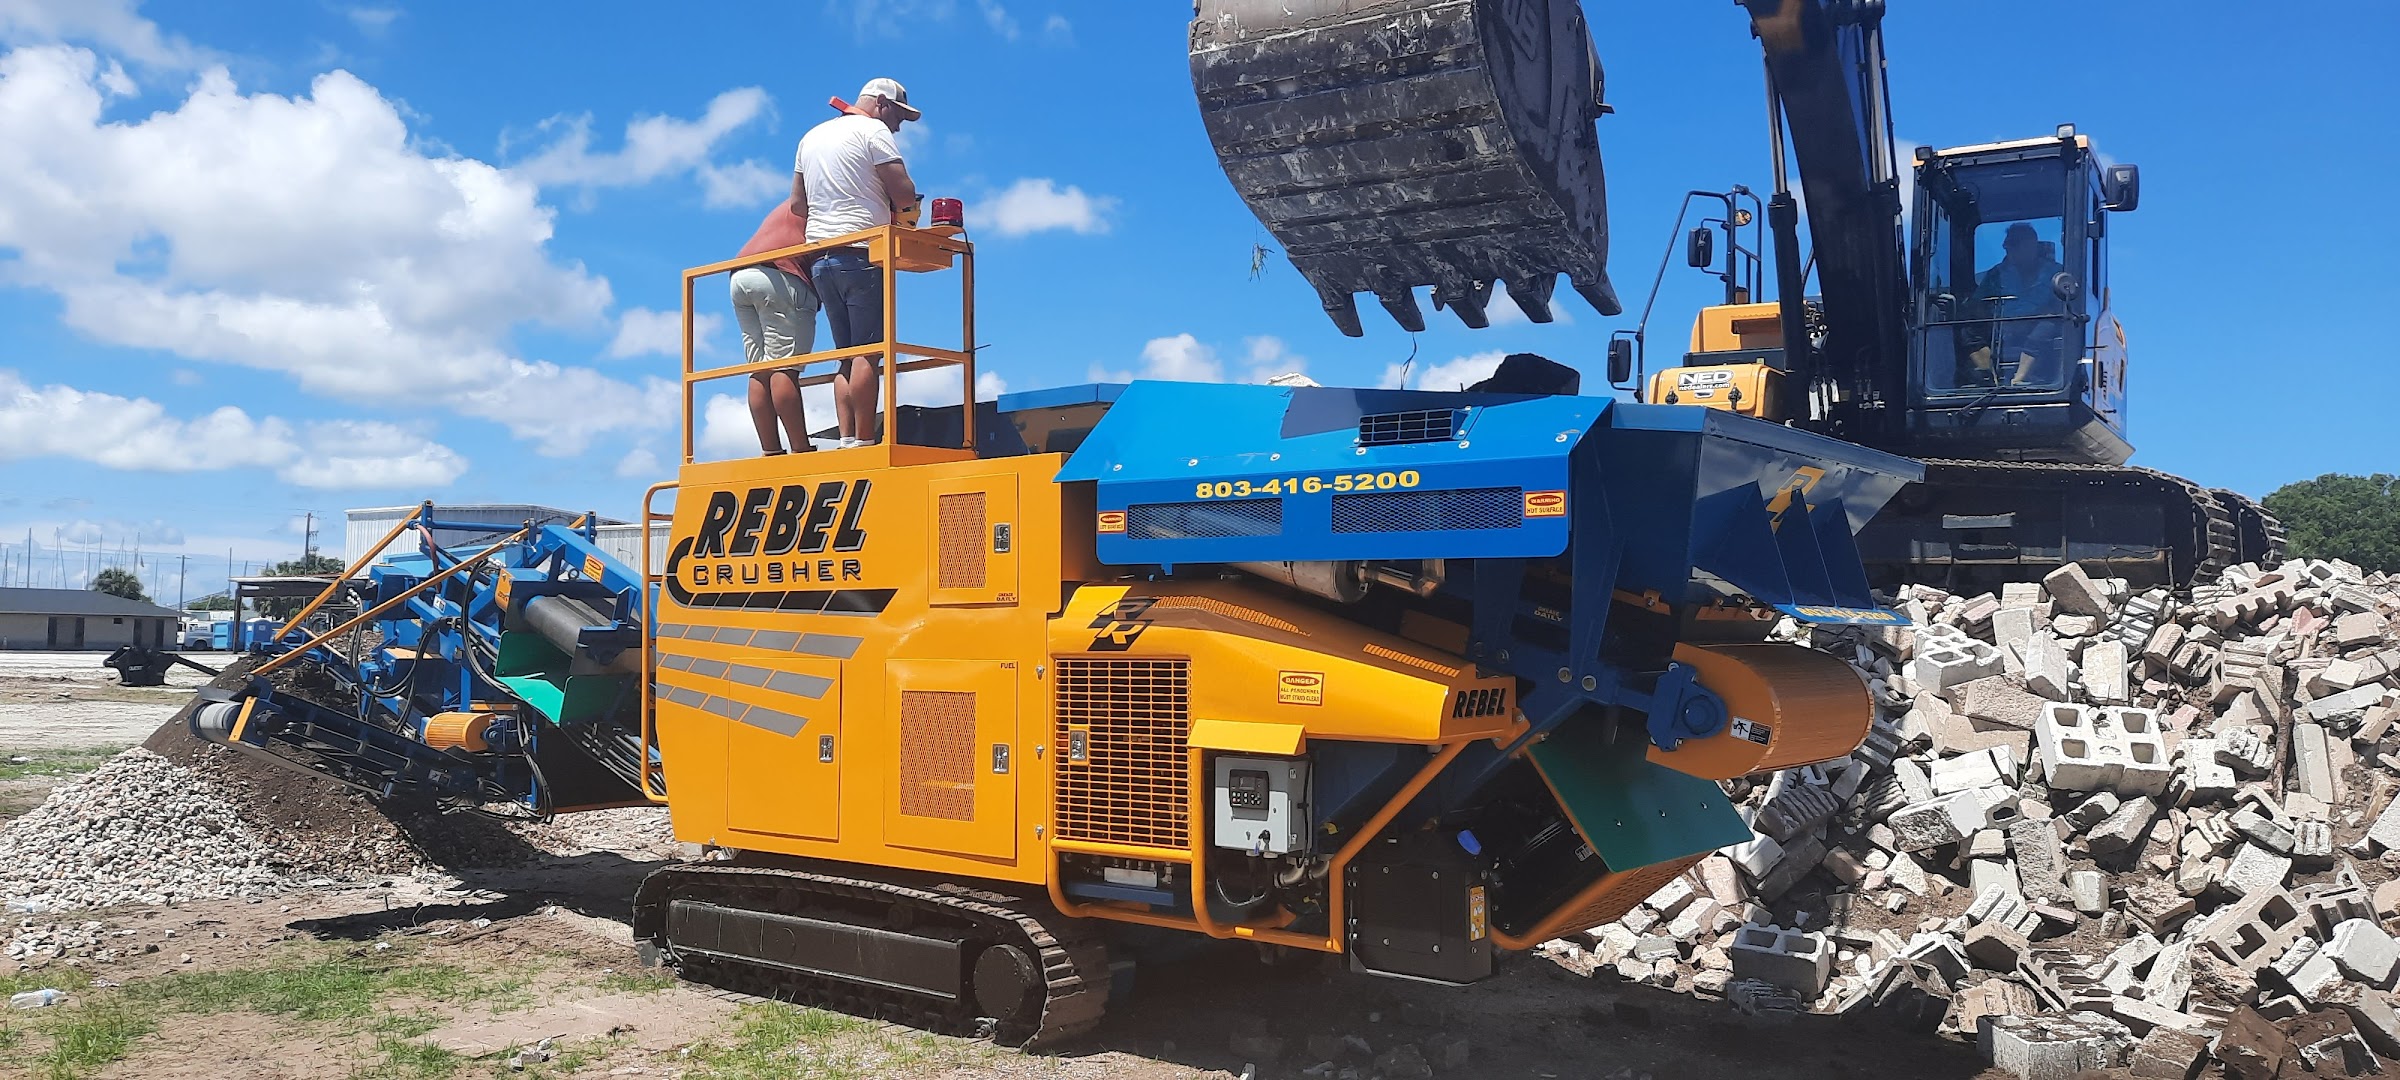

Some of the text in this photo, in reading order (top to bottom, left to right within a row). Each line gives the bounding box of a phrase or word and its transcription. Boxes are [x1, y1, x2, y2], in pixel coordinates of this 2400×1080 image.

[1680, 371, 1734, 385] NED
[1196, 470, 1420, 498] 803-416-5200
[693, 479, 872, 559] REBEL
[693, 559, 862, 585] CRUSHER
[1534, 610, 1563, 621] DAILY
[1452, 687, 1506, 719] REBEL
